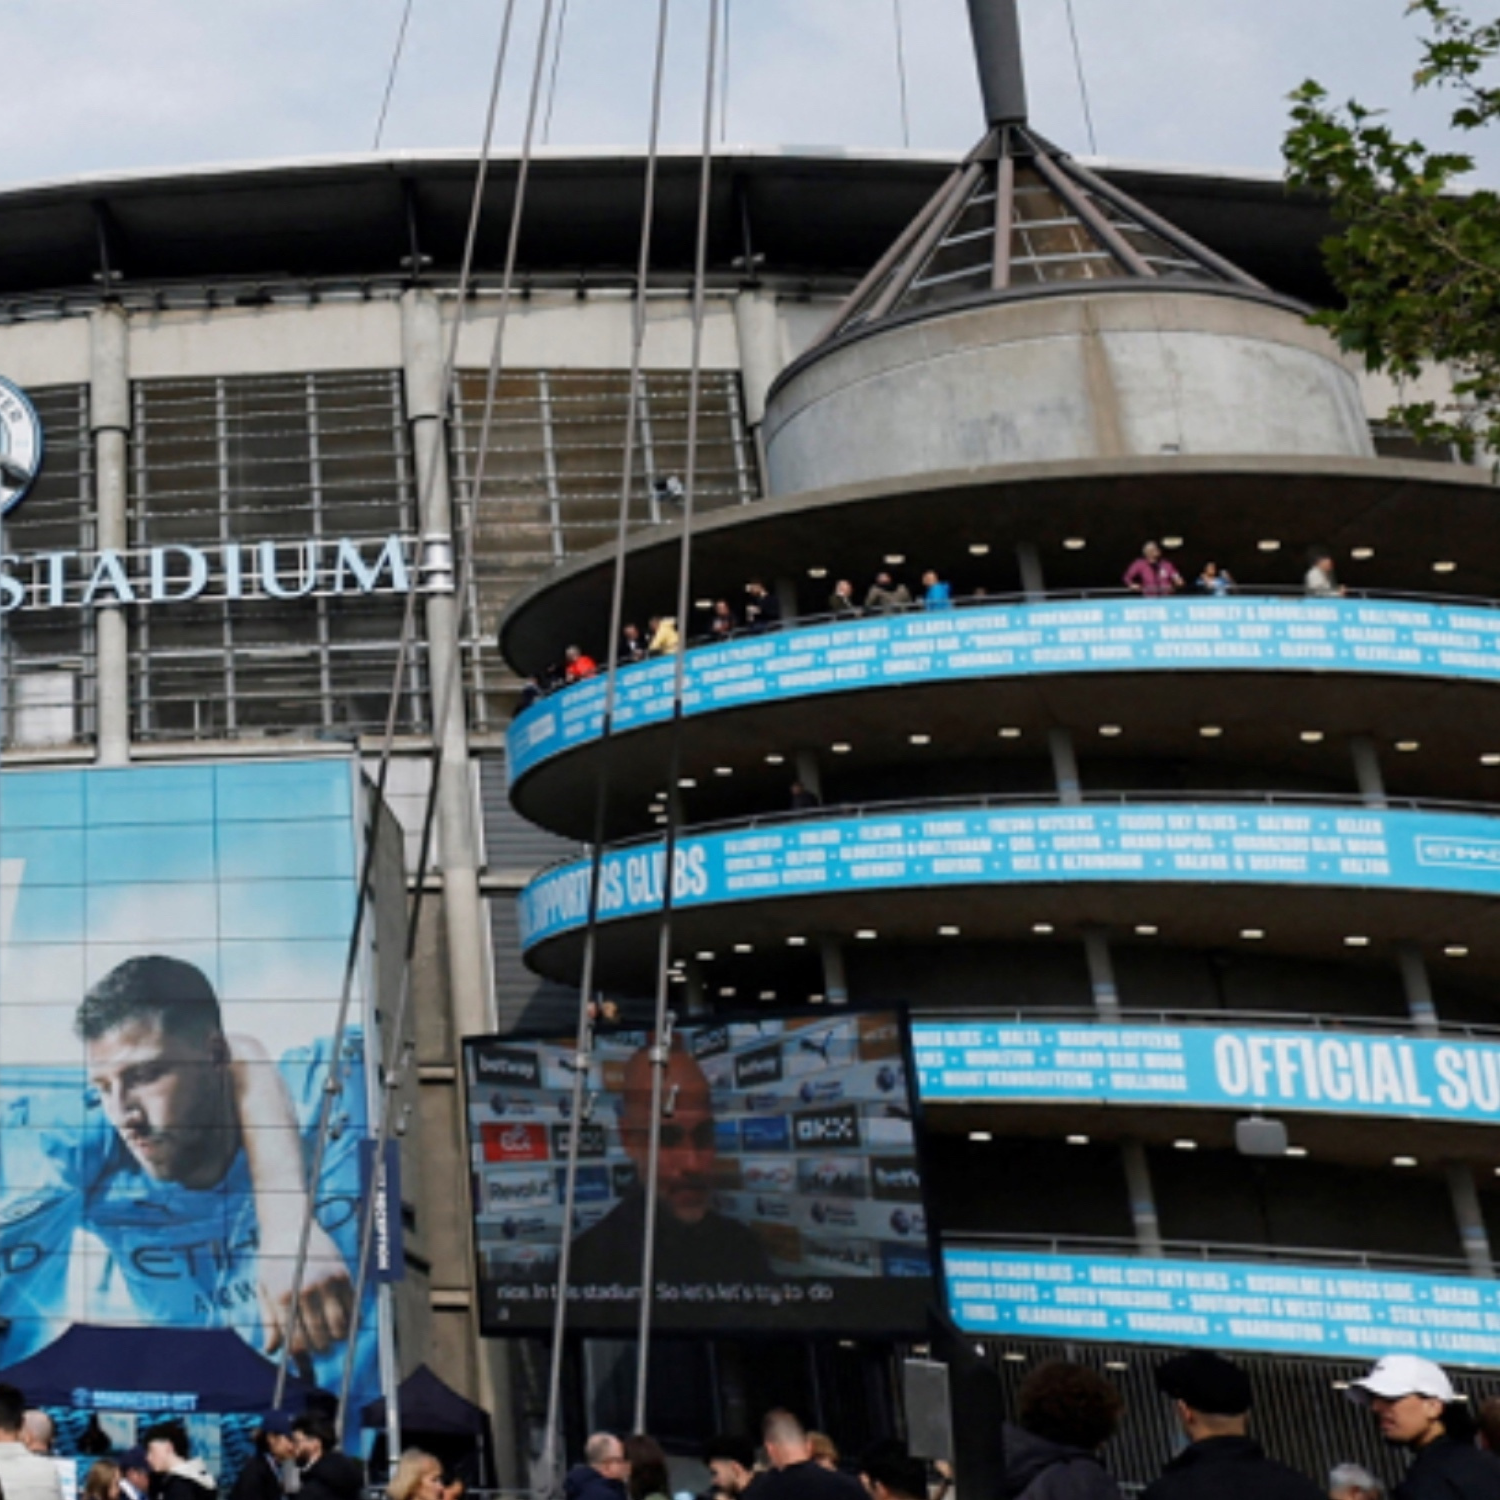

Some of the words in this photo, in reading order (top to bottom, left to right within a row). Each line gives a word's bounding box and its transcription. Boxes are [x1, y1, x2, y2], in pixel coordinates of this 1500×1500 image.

[528, 860, 624, 932] SUPPORTRS
[627, 844, 707, 906] CLUBS
[1213, 1034, 1432, 1107] OFFICIAL
[375, 1192, 390, 1270] RECEPTION
[656, 1283, 680, 1300] So
